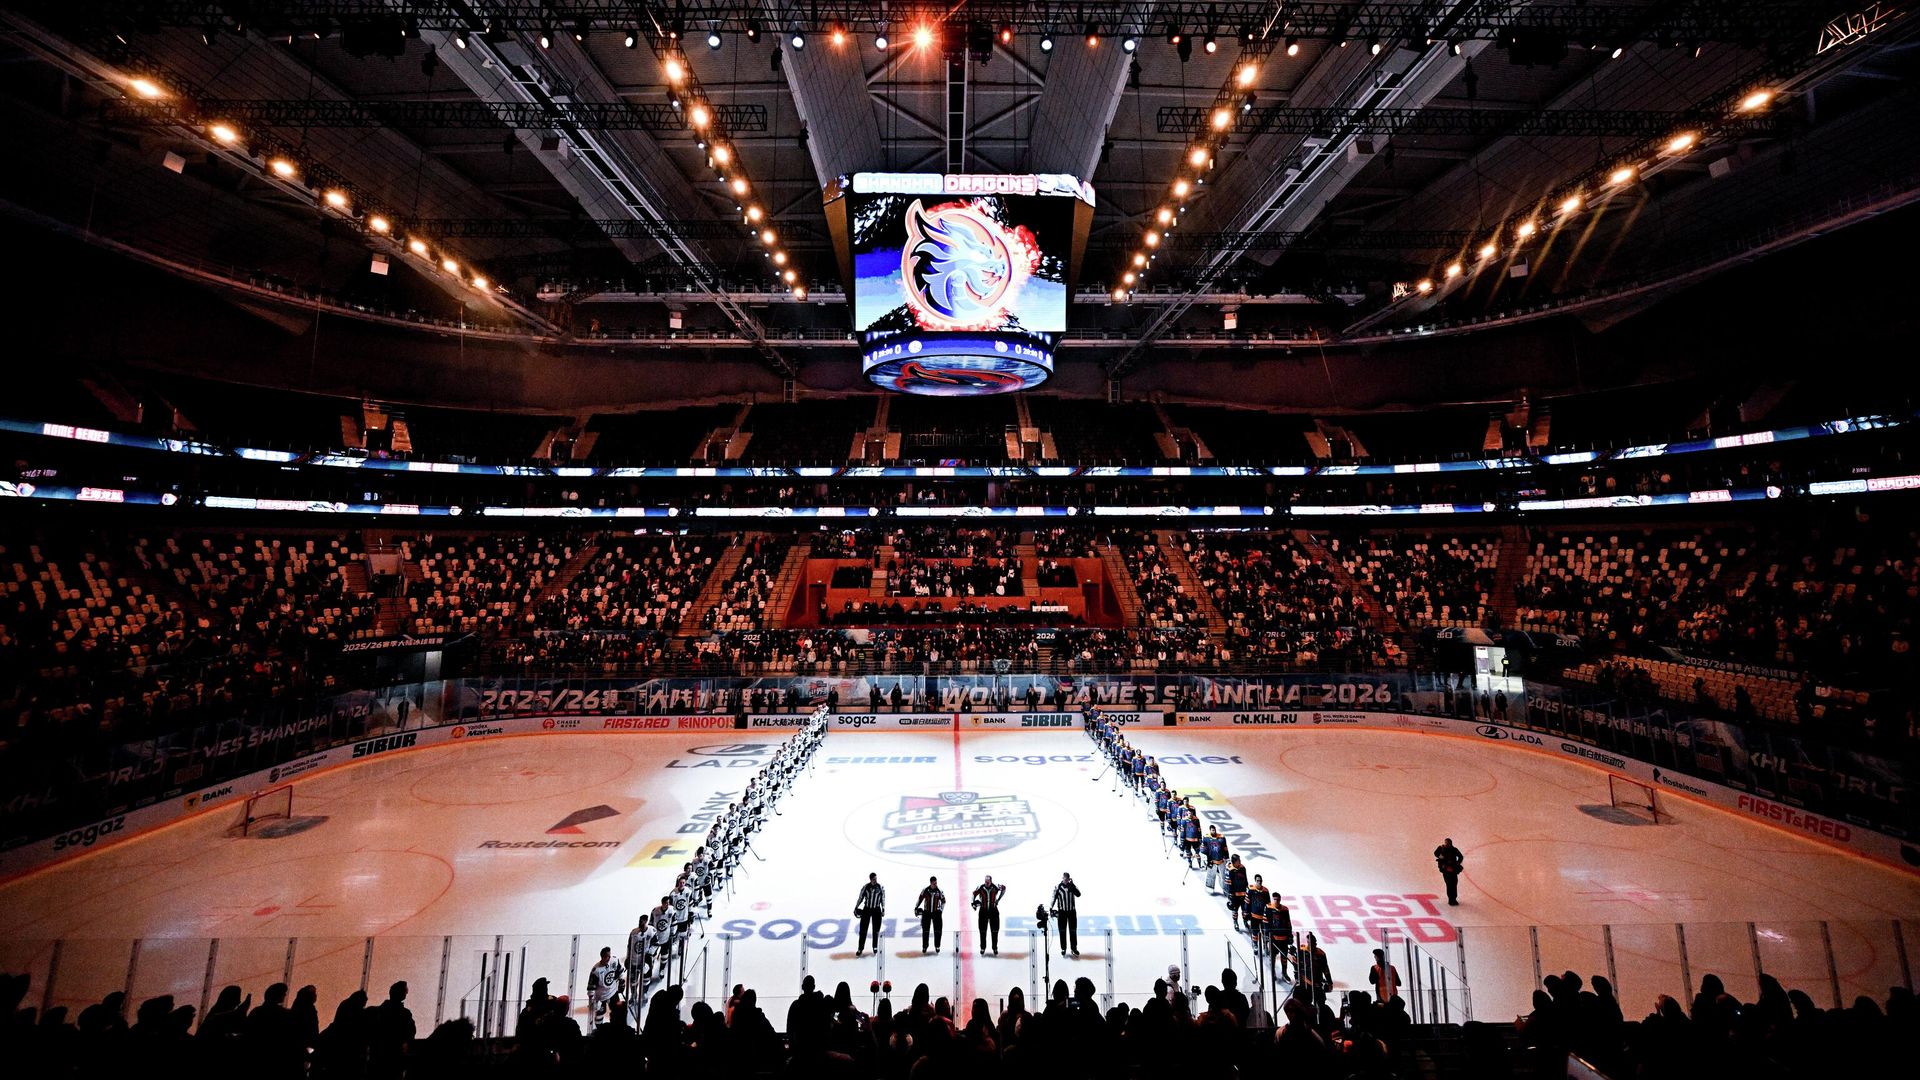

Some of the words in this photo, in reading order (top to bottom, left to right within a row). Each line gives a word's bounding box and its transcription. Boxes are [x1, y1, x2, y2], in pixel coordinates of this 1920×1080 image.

[946, 177, 1034, 192] DRAGONS
[44, 423, 74, 438] HOME
[1036, 633, 1056, 641] 2026
[1556, 638, 1577, 648] EXIT
[1321, 684, 1391, 704] 2026
[603, 718, 671, 730] FIRST&RED
[678, 717, 737, 729] KINOPOIS
[838, 715, 877, 728] sogaz
[1021, 715, 1073, 727] SIBUR
[1233, 714, 1298, 725] CN.KHL.RU
[467, 728, 503, 737] Market
[1510, 732, 1544, 746] LADA
[352, 733, 416, 759] SIBUR
[825, 756, 937, 764] SIBUR
[974, 755, 1095, 765] sogaz
[1146, 754, 1243, 765] aier
[1662, 775, 1708, 798] Rostelecom
[202, 786, 233, 803] BANK
[651, 846, 688, 859] T
[676, 791, 740, 834] BANK
[916, 821, 971, 834] WORLD
[973, 816, 1025, 829] GAMES
[1738, 794, 1851, 843] FIRST&RED
[52, 816, 125, 851] sogaz
[1200, 810, 1278, 861] BANK
[478, 839, 621, 849] Rostelecom
[1281, 893, 1442, 918] FIRST
[1313, 918, 1458, 944] RED
